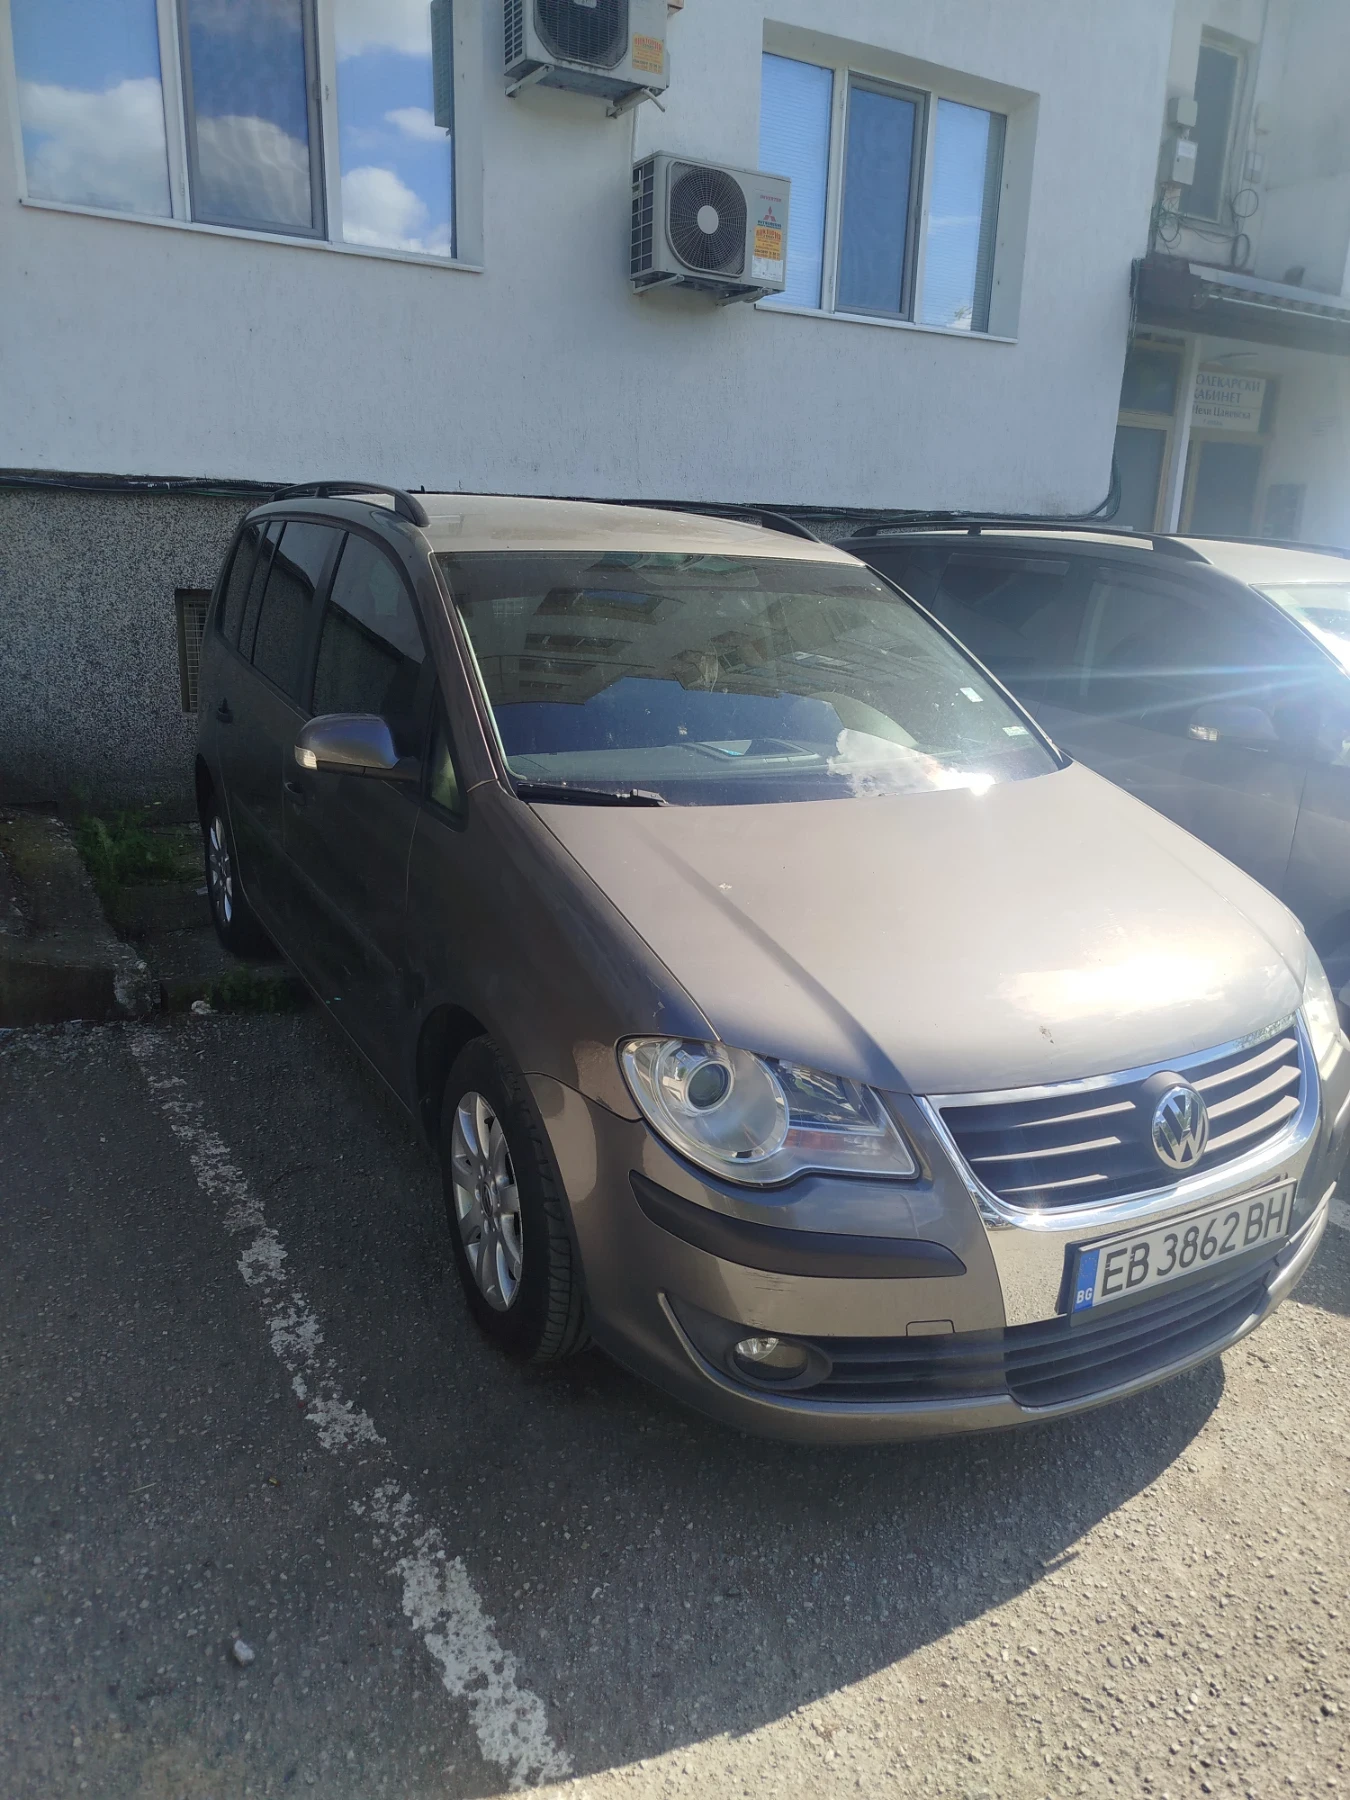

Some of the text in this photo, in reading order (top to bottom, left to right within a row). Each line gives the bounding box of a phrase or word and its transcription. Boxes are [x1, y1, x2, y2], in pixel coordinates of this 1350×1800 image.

[1101, 1192, 1288, 1298] EB 3862 BH
[1076, 1287, 1093, 1304] BG
